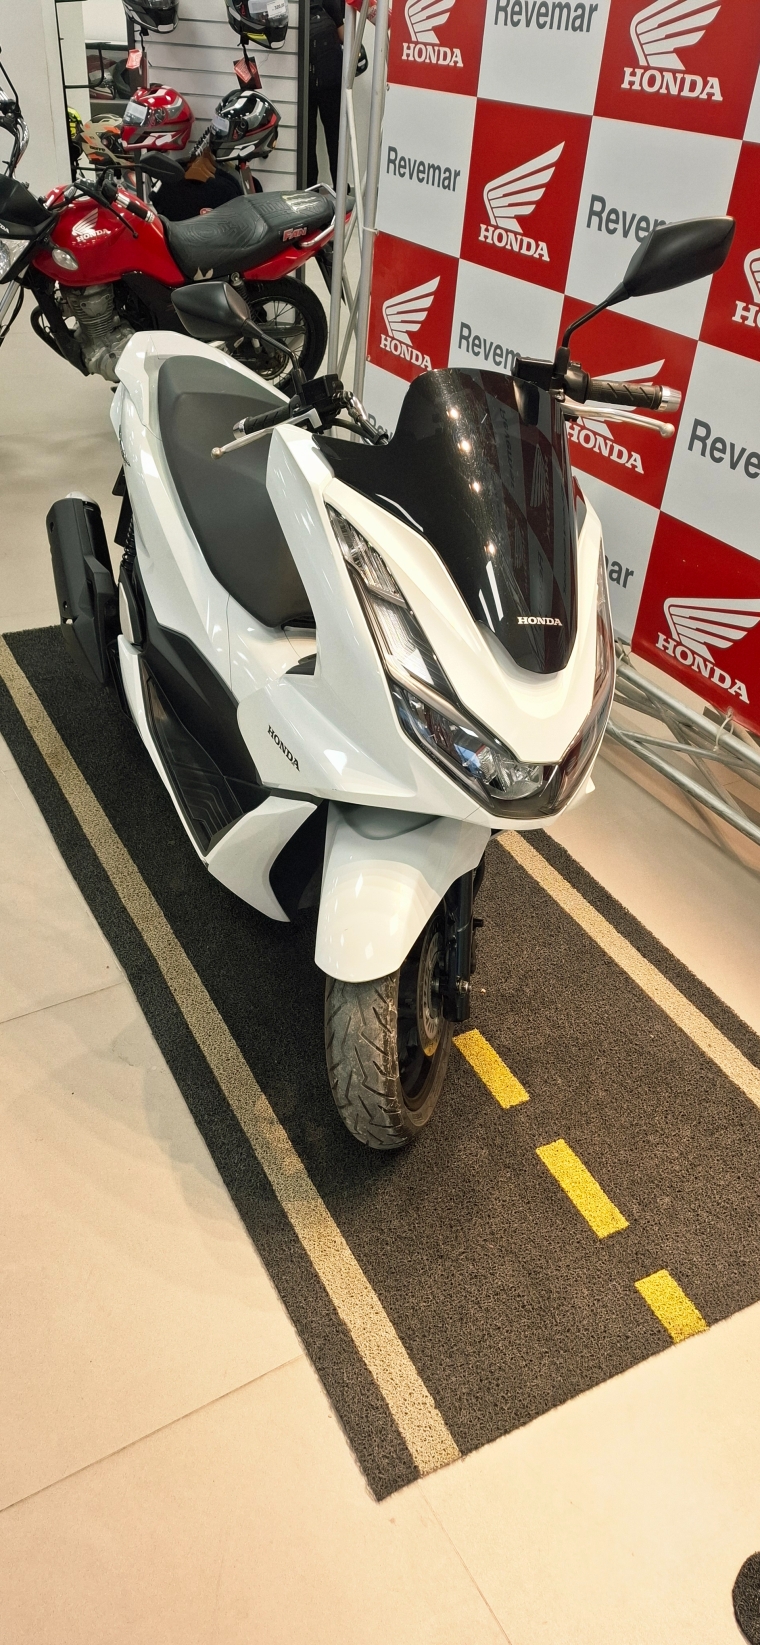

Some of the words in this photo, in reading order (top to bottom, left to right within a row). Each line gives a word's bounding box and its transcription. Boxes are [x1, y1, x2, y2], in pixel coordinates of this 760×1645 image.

[494, 0, 599, 33] Revemar
[401, 43, 464, 68] HONDA
[621, 67, 723, 101] HONDA
[386, 145, 461, 192] Revemar
[76, 228, 111, 242] HONDA
[282, 227, 308, 242] FAN
[478, 223, 550, 262] HONDA
[380, 333, 433, 371] HONDA
[564, 420, 645, 475] HONDA
[687, 417, 760, 479] Reve
[604, 554, 635, 589] ar
[516, 616, 563, 627] HONDA
[655, 631, 750, 704] HONDA
[267, 724, 301, 772] HONDA
